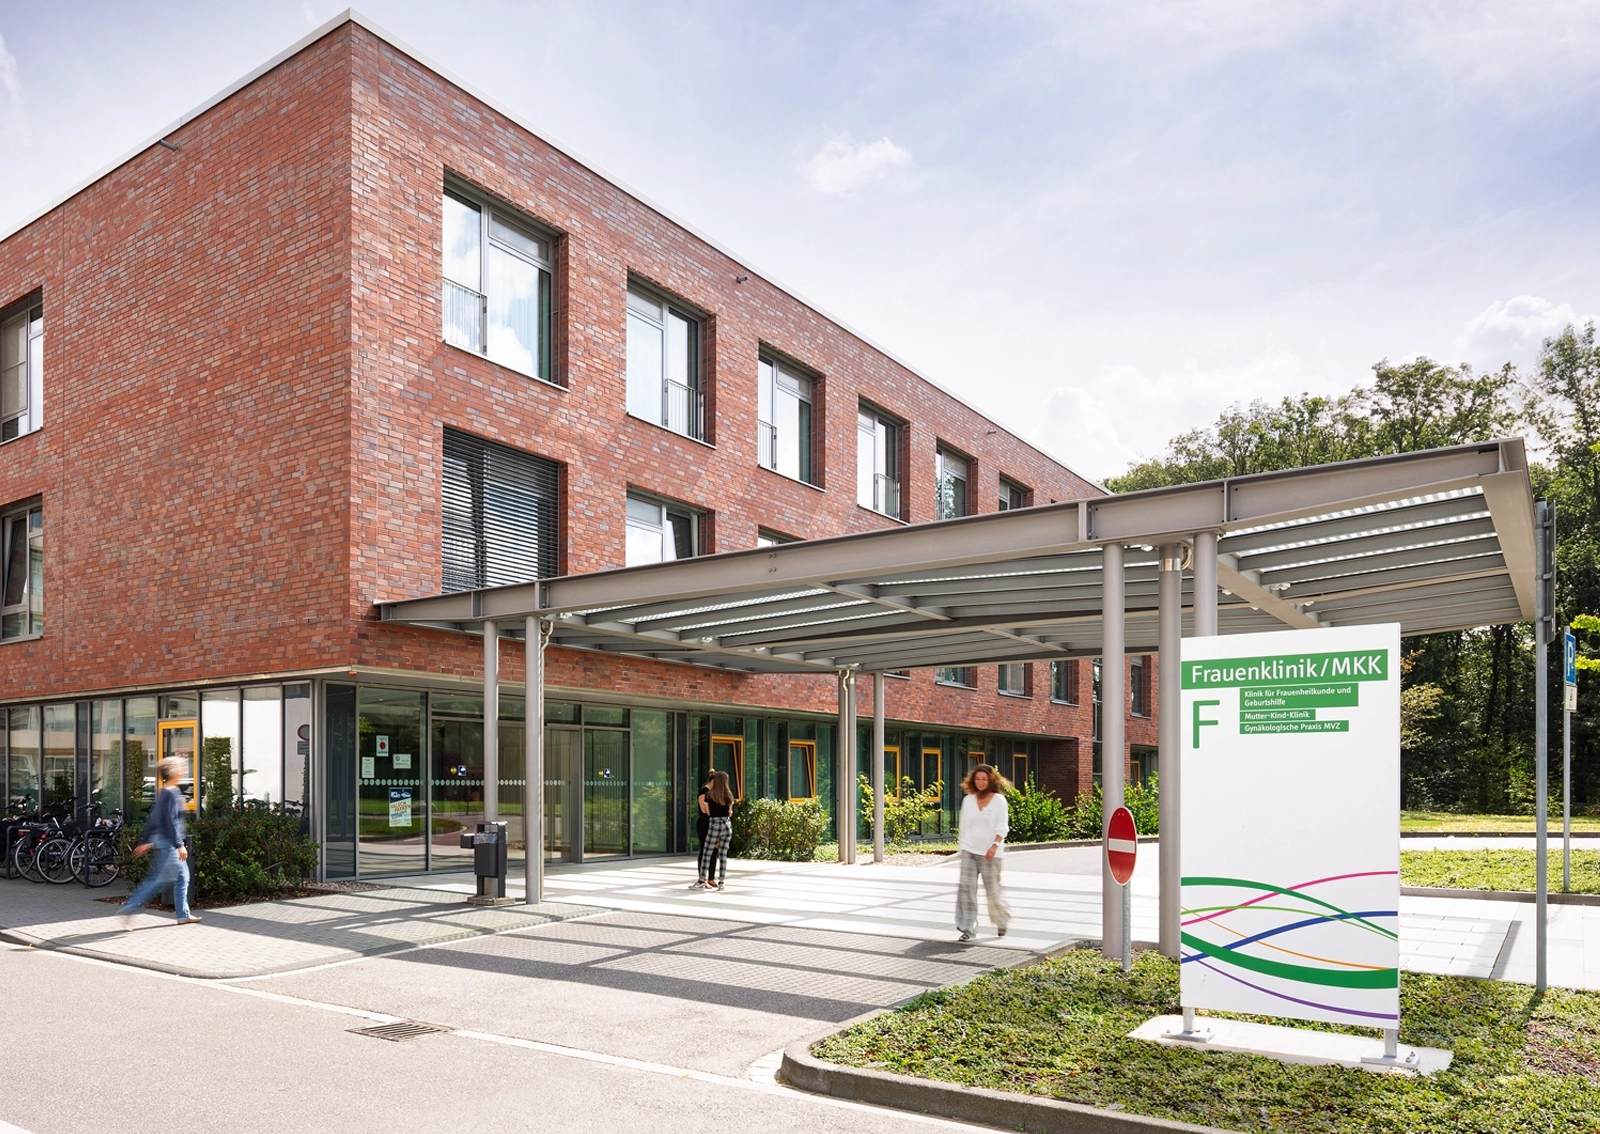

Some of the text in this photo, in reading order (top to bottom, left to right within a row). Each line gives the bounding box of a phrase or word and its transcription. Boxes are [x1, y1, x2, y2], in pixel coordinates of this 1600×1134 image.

[1568, 640, 1574, 676] P
[1192, 655, 1382, 683] Frauenklinik/MKK
[1244, 686, 1352, 698] Klinik für Frauenheilkunde und
[1244, 698, 1286, 707] Geburtshilfe
[1244, 711, 1310, 720] Mutter-Kind-Klinik
[1193, 700, 1220, 749] F
[1244, 722, 1341, 733] Gynäkologische Praxis MVZ
